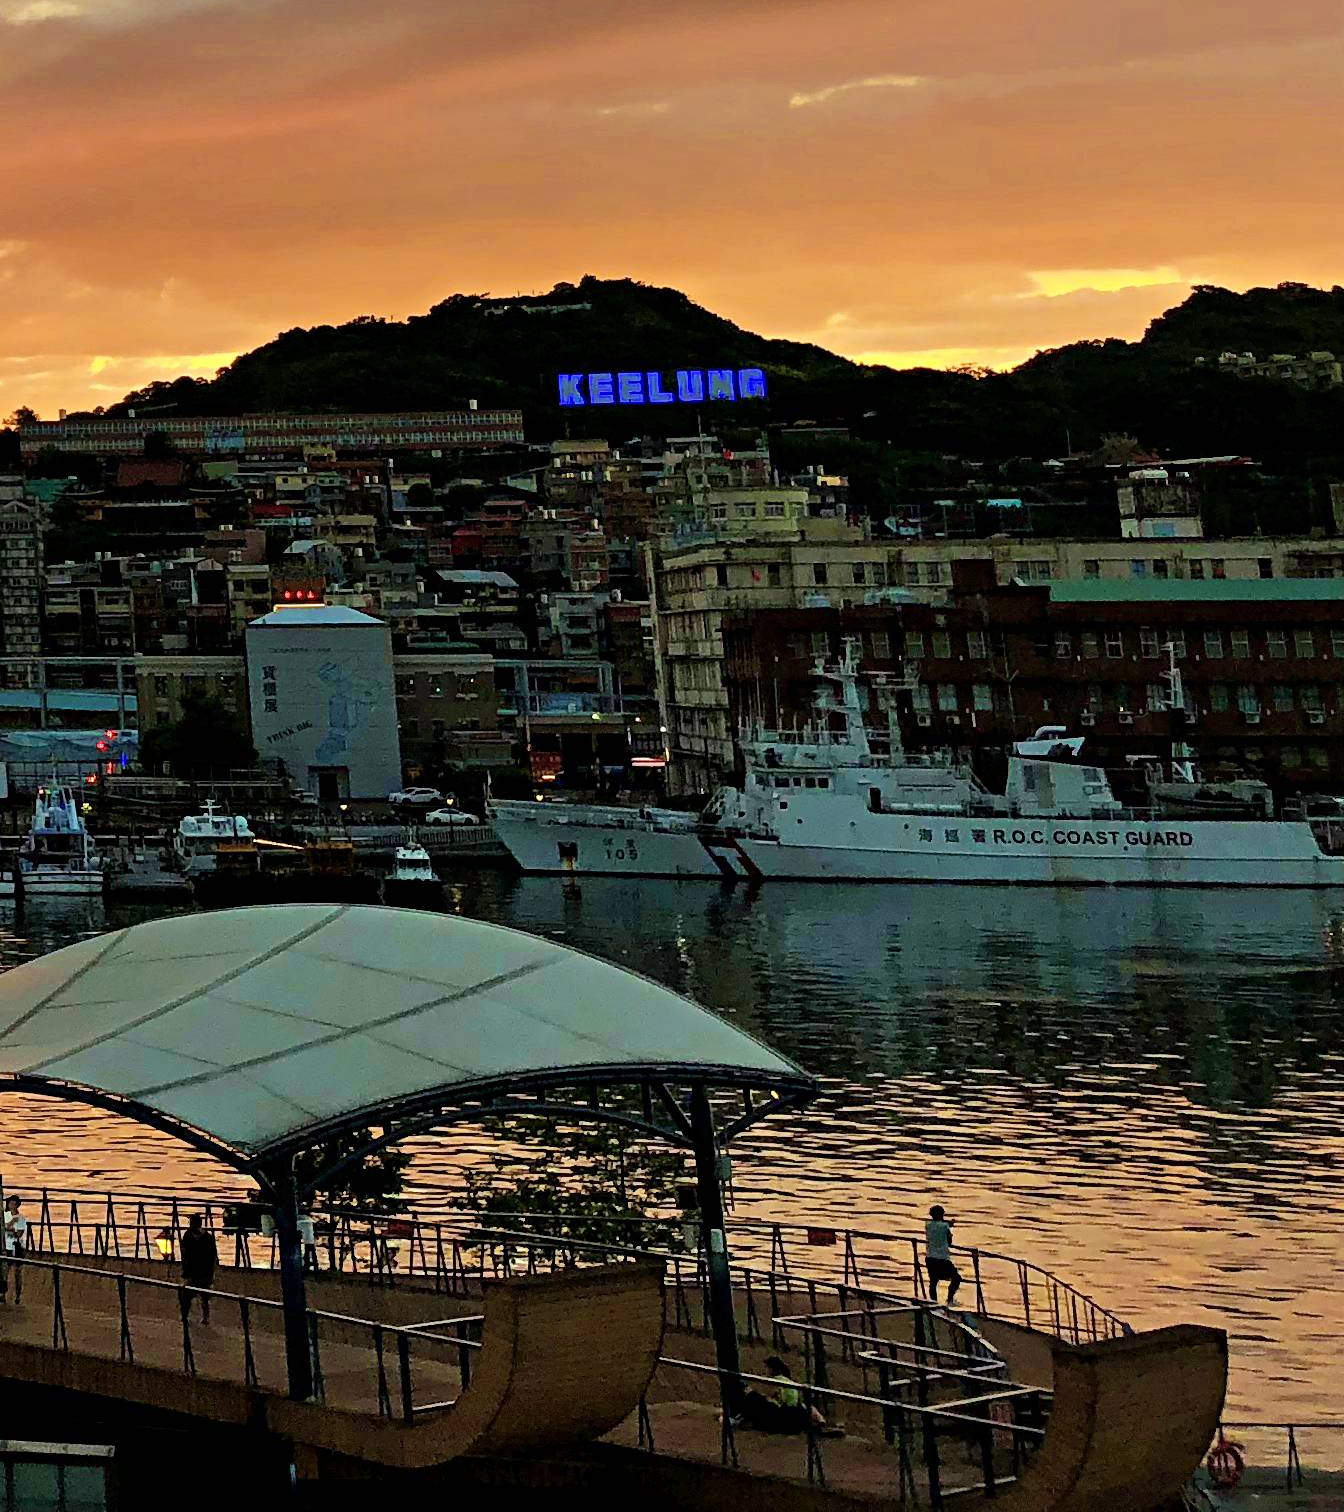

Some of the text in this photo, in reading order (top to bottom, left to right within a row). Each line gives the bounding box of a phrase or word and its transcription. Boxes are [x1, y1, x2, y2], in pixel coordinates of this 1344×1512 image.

[558, 369, 765, 406] KEELUNG
[993, 829, 1049, 845] R.O.C.
[1053, 830, 1120, 846] COAST
[1125, 831, 1193, 847] GUARD
[606, 849, 638, 861] 105
